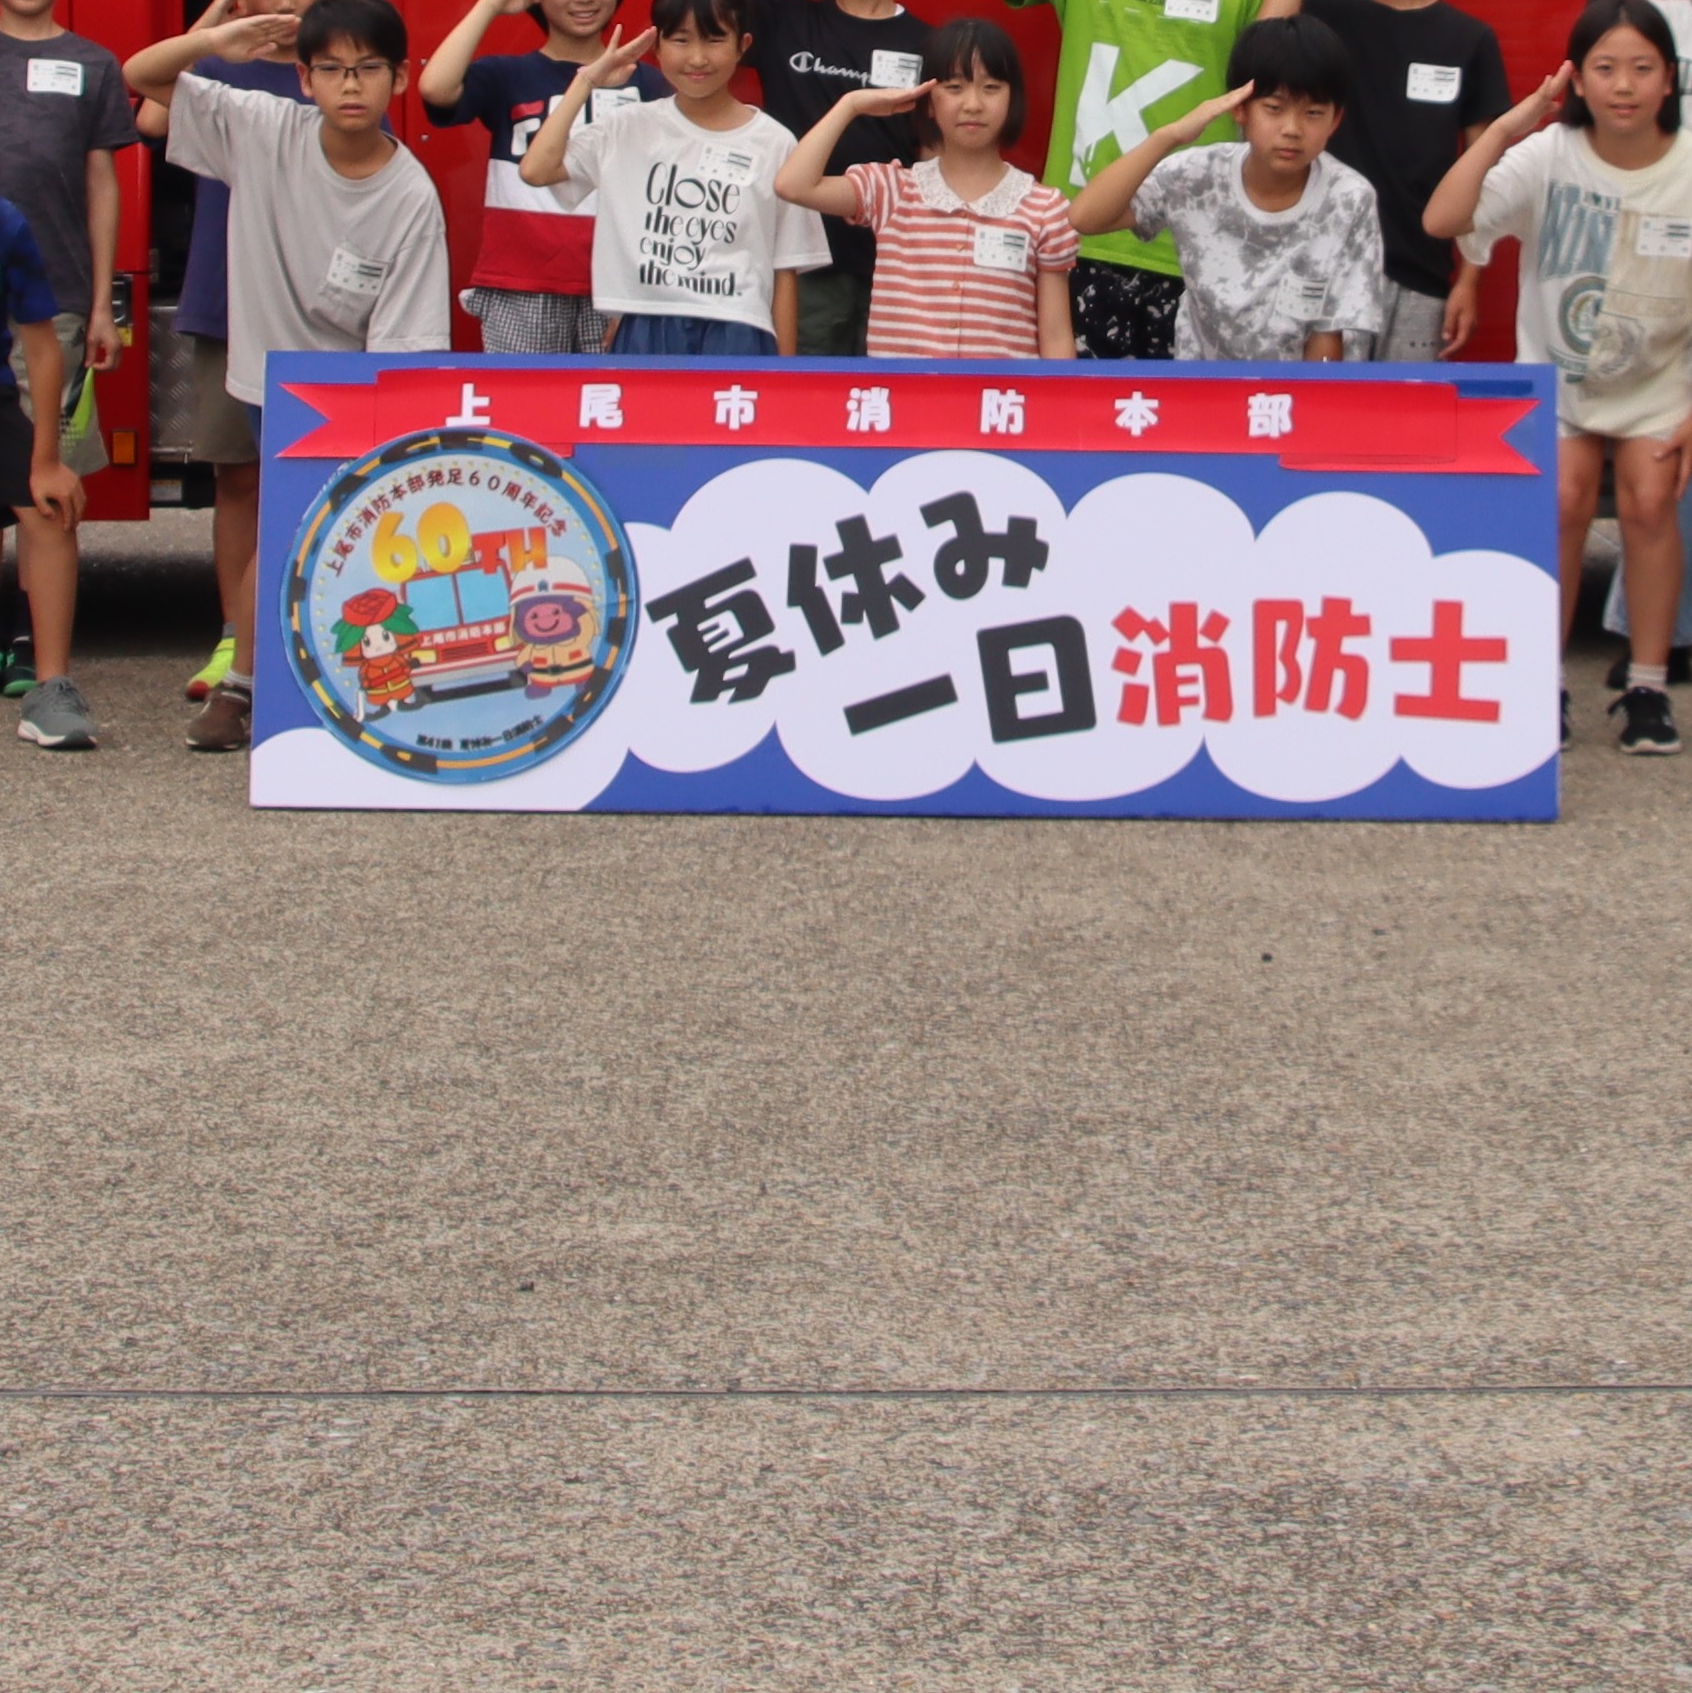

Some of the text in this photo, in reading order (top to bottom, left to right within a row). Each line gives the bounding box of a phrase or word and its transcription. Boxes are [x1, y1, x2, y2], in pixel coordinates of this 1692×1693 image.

[1069, 42, 1205, 188] K
[646, 161, 740, 215] Close
[645, 206, 737, 246] the eyes
[640, 236, 706, 271] enjoy
[640, 259, 743, 297] the mind.
[445, 383, 1293, 438] 上尾市消防本部
[645, 491, 1049, 705] 夏休み
